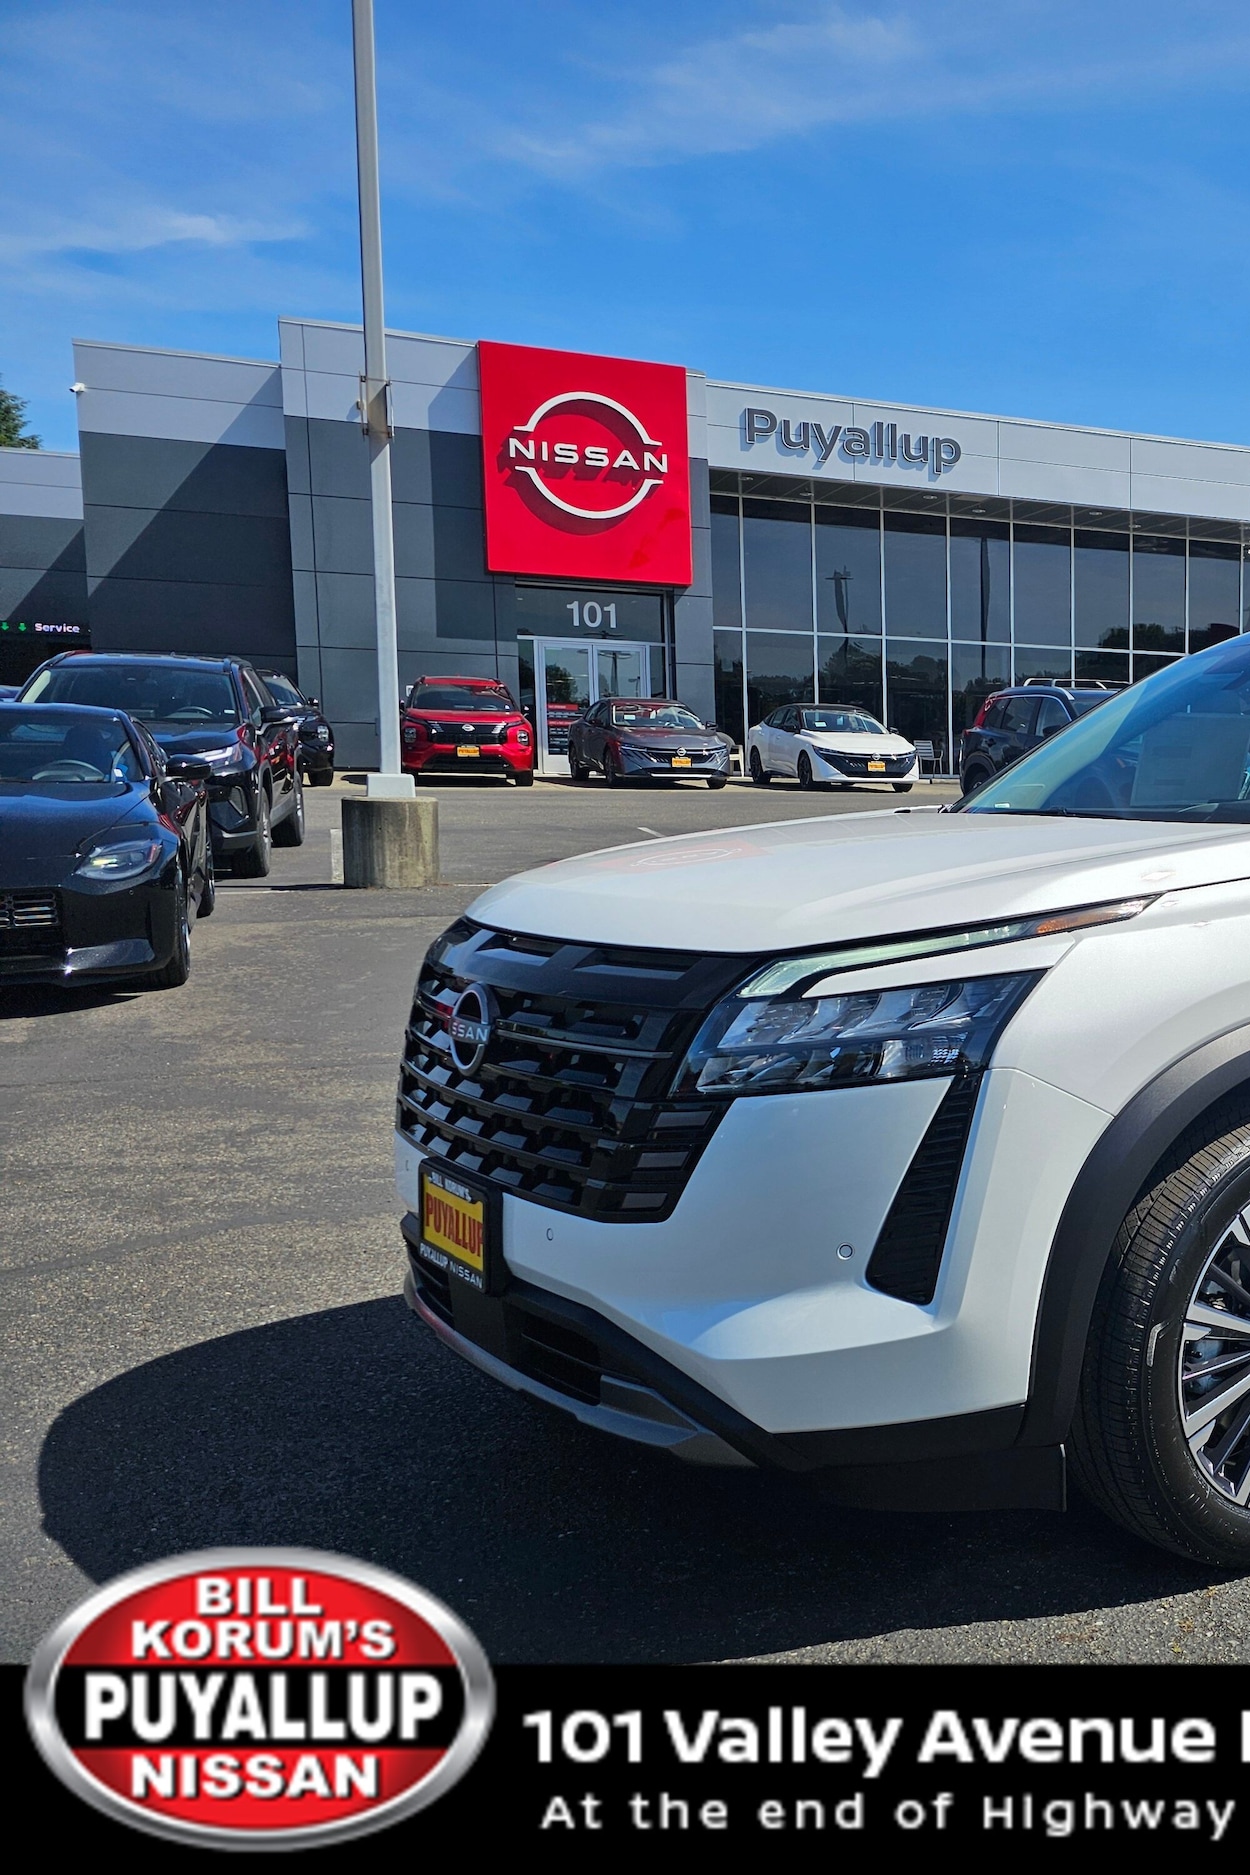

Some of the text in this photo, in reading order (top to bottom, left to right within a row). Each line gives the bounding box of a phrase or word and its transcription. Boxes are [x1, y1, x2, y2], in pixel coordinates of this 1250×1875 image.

[508, 437, 669, 474] NISSAN
[744, 407, 962, 475] Puyallup
[566, 600, 618, 629] 101
[34, 622, 81, 638] Service
[452, 1022, 489, 1042] SSAN
[425, 1192, 483, 1258] PUYALLUP
[449, 1260, 483, 1289] NISSAN
